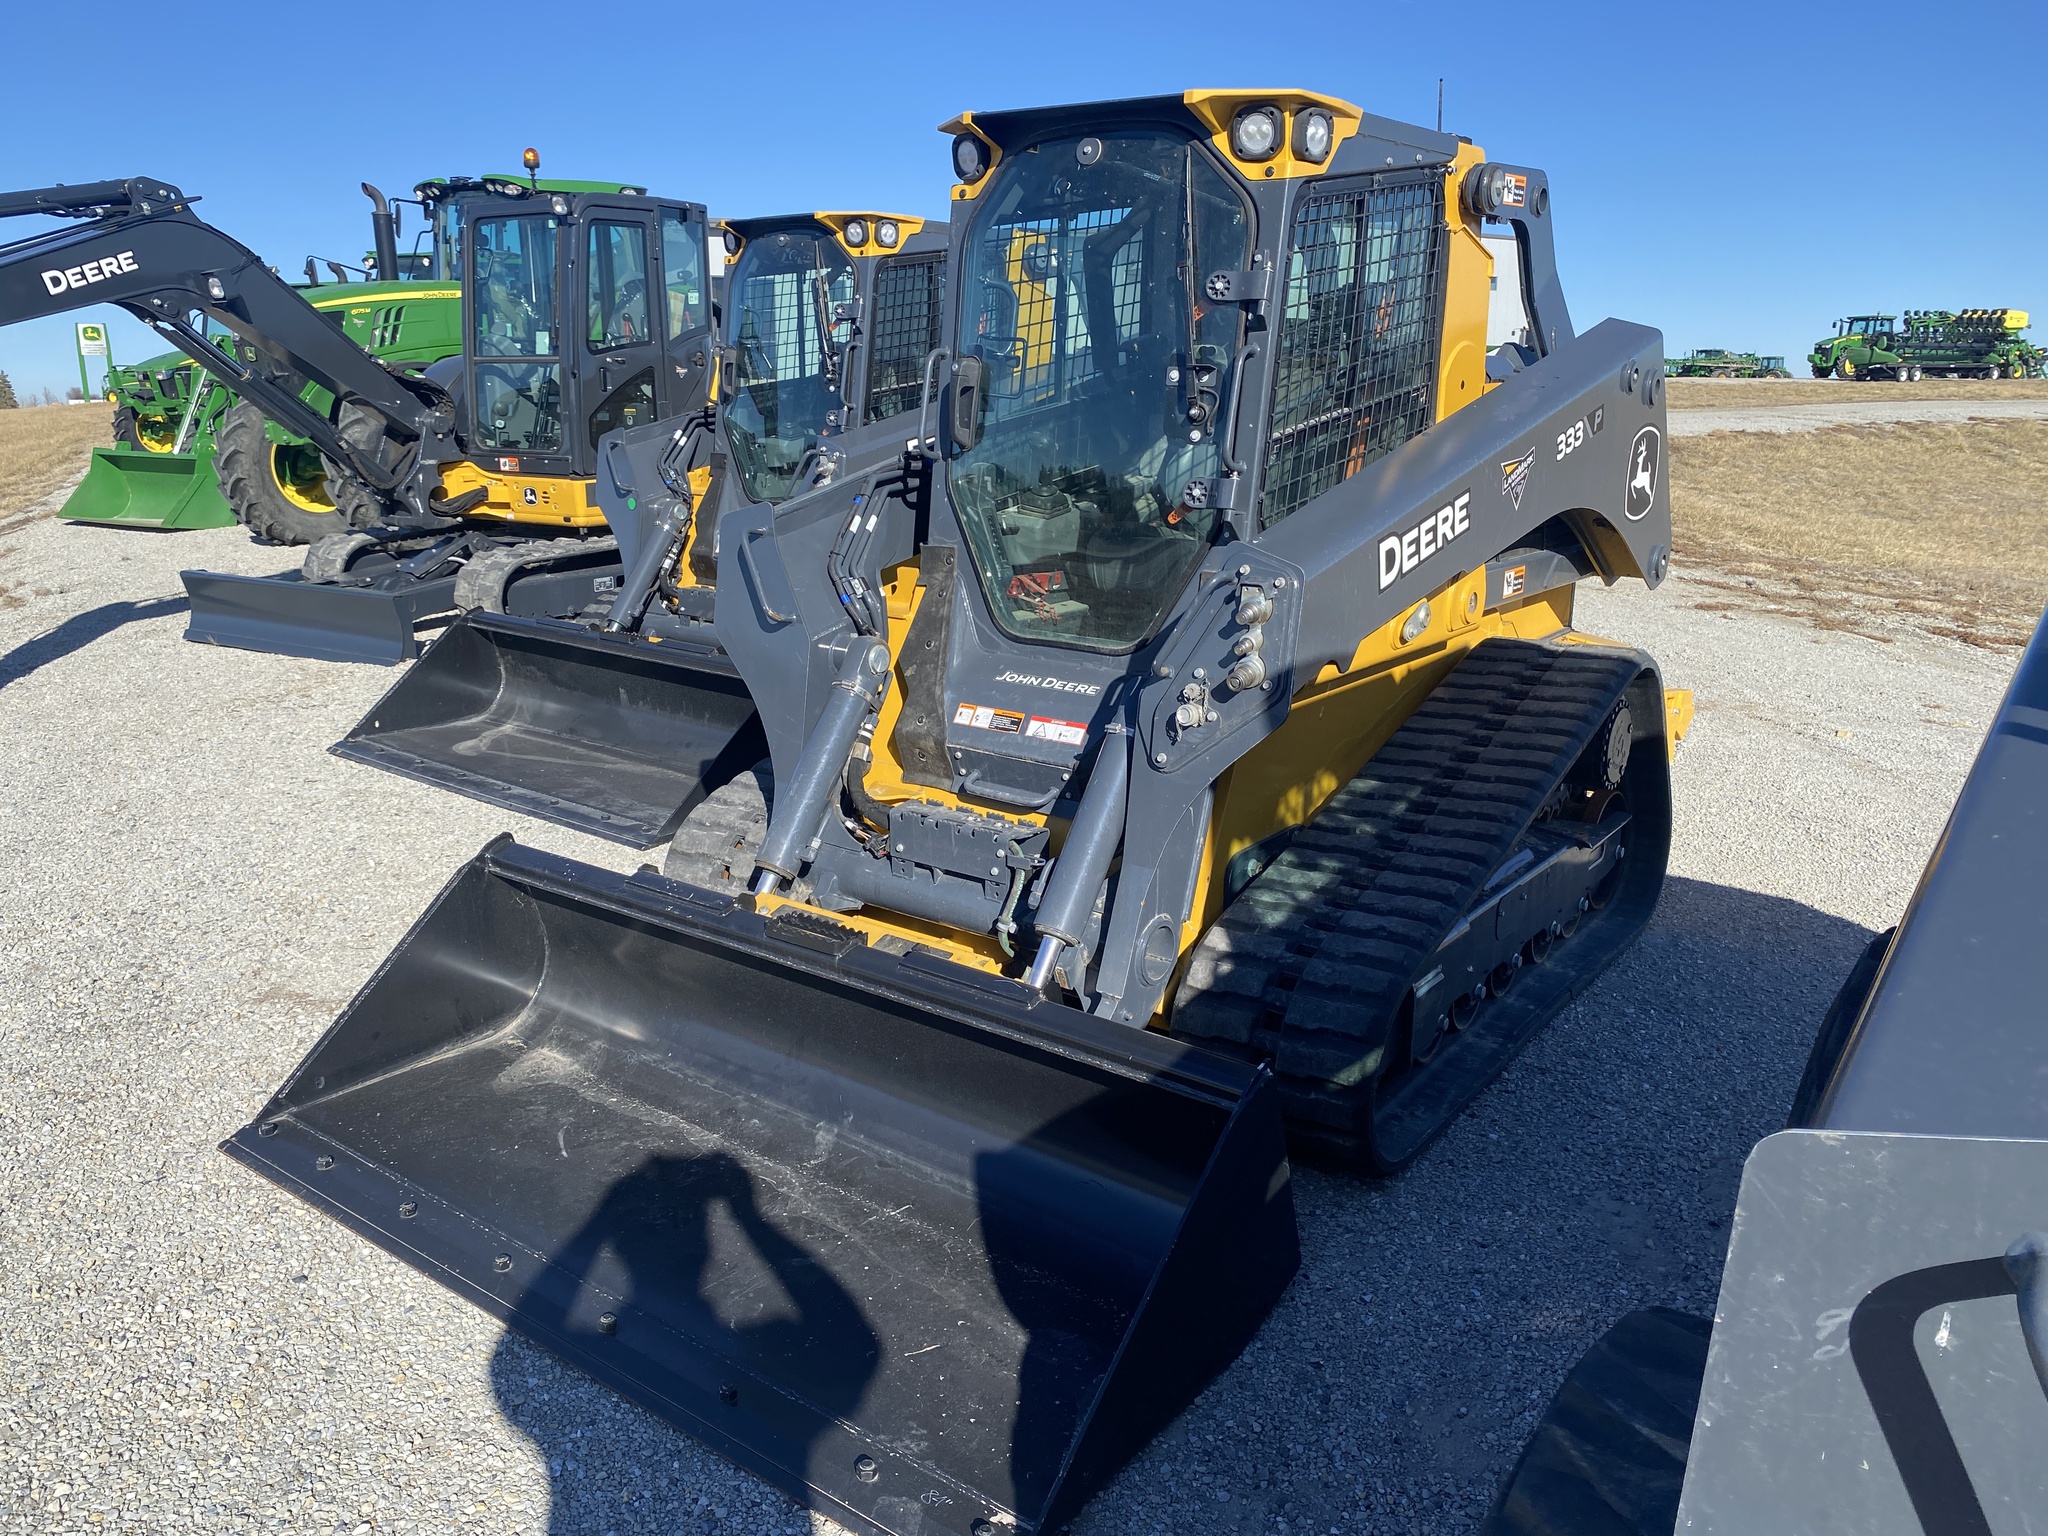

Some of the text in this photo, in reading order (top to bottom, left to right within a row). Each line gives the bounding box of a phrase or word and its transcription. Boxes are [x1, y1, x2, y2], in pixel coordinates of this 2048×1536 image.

[41, 250, 139, 295] DEERE
[1556, 420, 1584, 461] 333
[1379, 492, 1470, 590] DEERE
[995, 671, 1101, 695] JOHN DEERE
